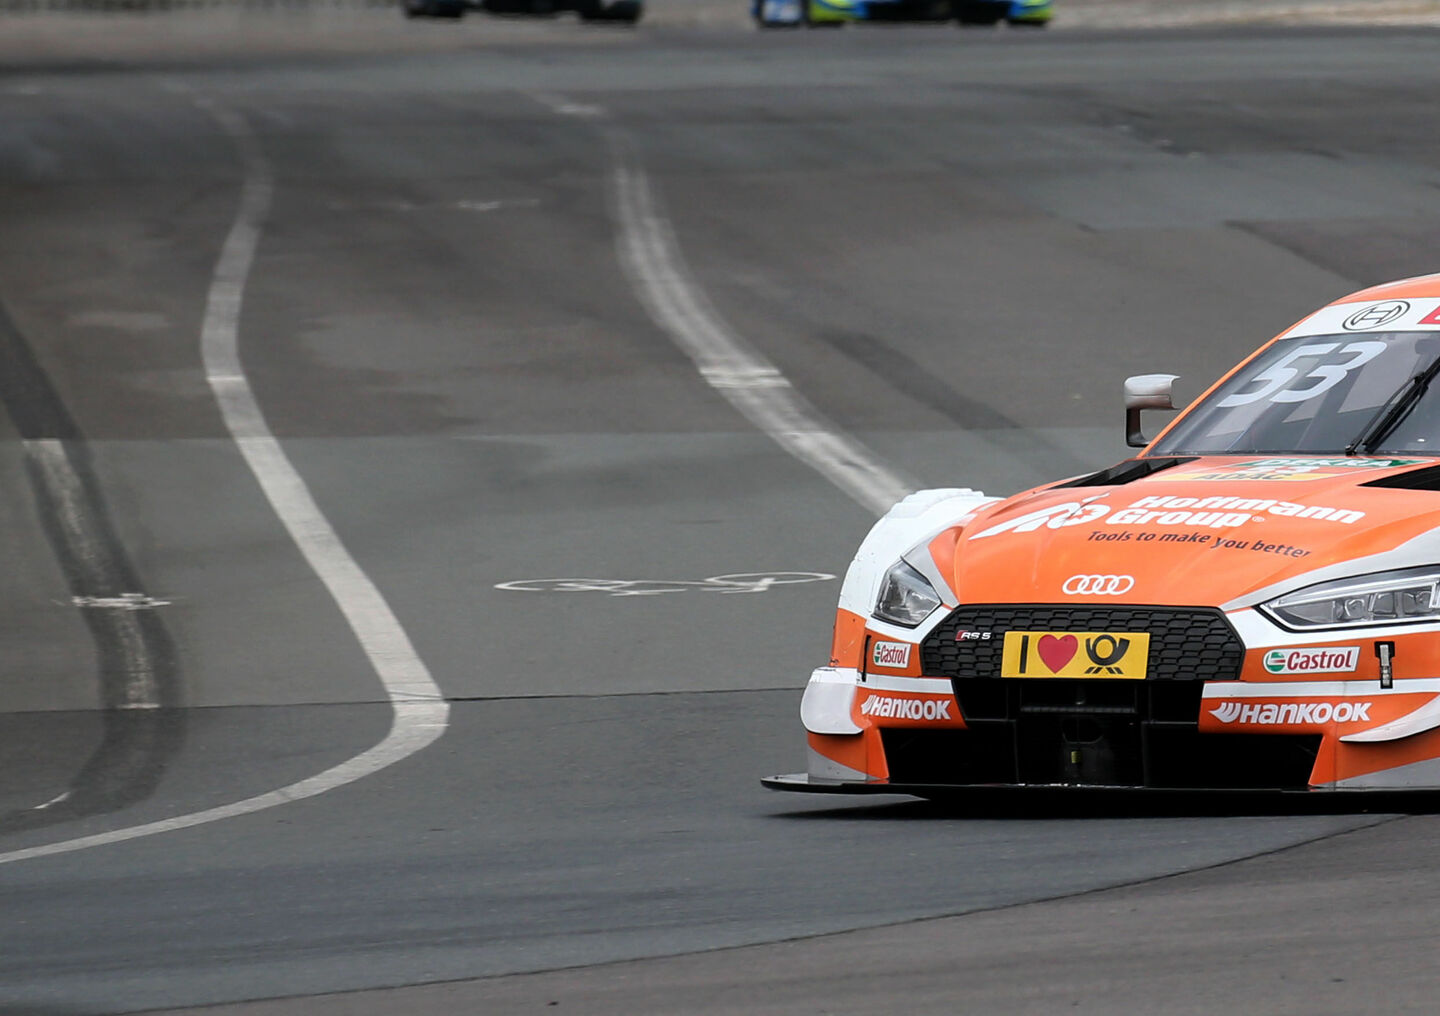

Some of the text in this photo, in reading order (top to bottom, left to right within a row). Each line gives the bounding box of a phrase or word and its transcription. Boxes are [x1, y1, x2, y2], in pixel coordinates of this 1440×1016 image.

[1216, 340, 1388, 408] 53
[1258, 457, 1394, 467] DEKRA
[1192, 472, 1296, 481] ADAC
[1126, 494, 1367, 524] Hoffmann
[1087, 530, 1312, 558] Tools to make you better
[880, 644, 907, 665] Castrol
[1018, 634, 1030, 674] I
[1286, 649, 1353, 671] Castrol
